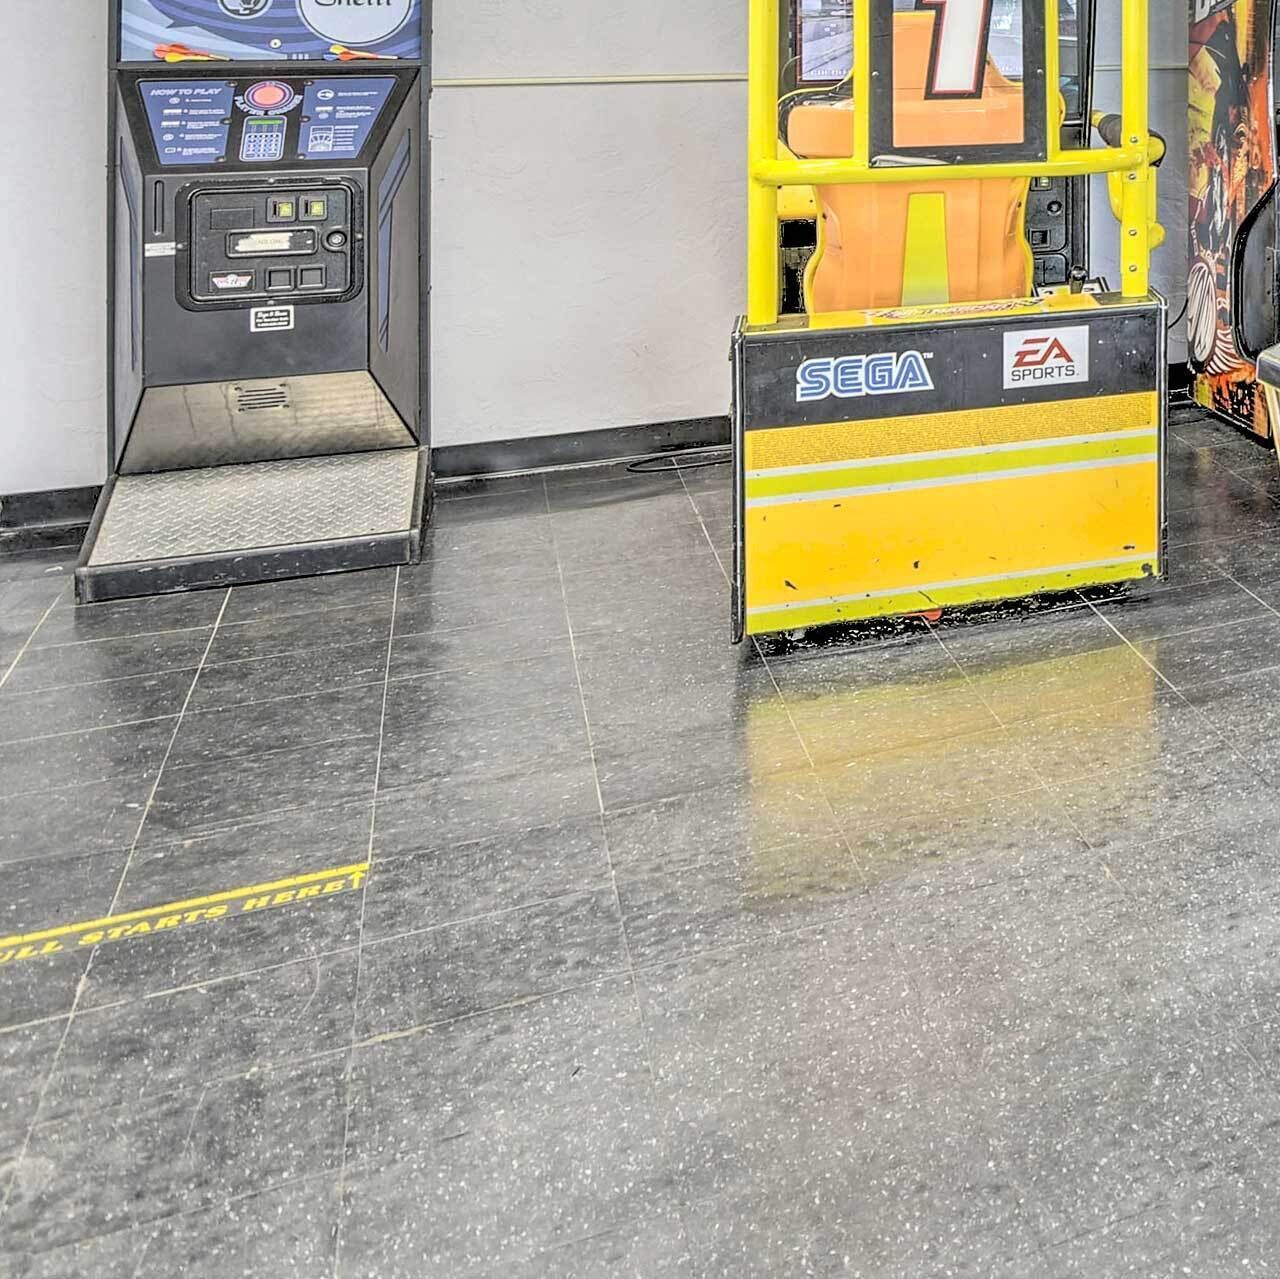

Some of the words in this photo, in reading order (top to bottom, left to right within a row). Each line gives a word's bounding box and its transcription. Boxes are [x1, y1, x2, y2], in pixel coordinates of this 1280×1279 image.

[150, 88, 179, 96] HOW
[193, 87, 222, 95] PLAY
[1012, 336, 1075, 368] EA
[796, 350, 934, 402] SEGA
[1011, 364, 1076, 382] SPORTS
[78, 904, 229, 947] STARTS
[241, 880, 347, 911] HERE
